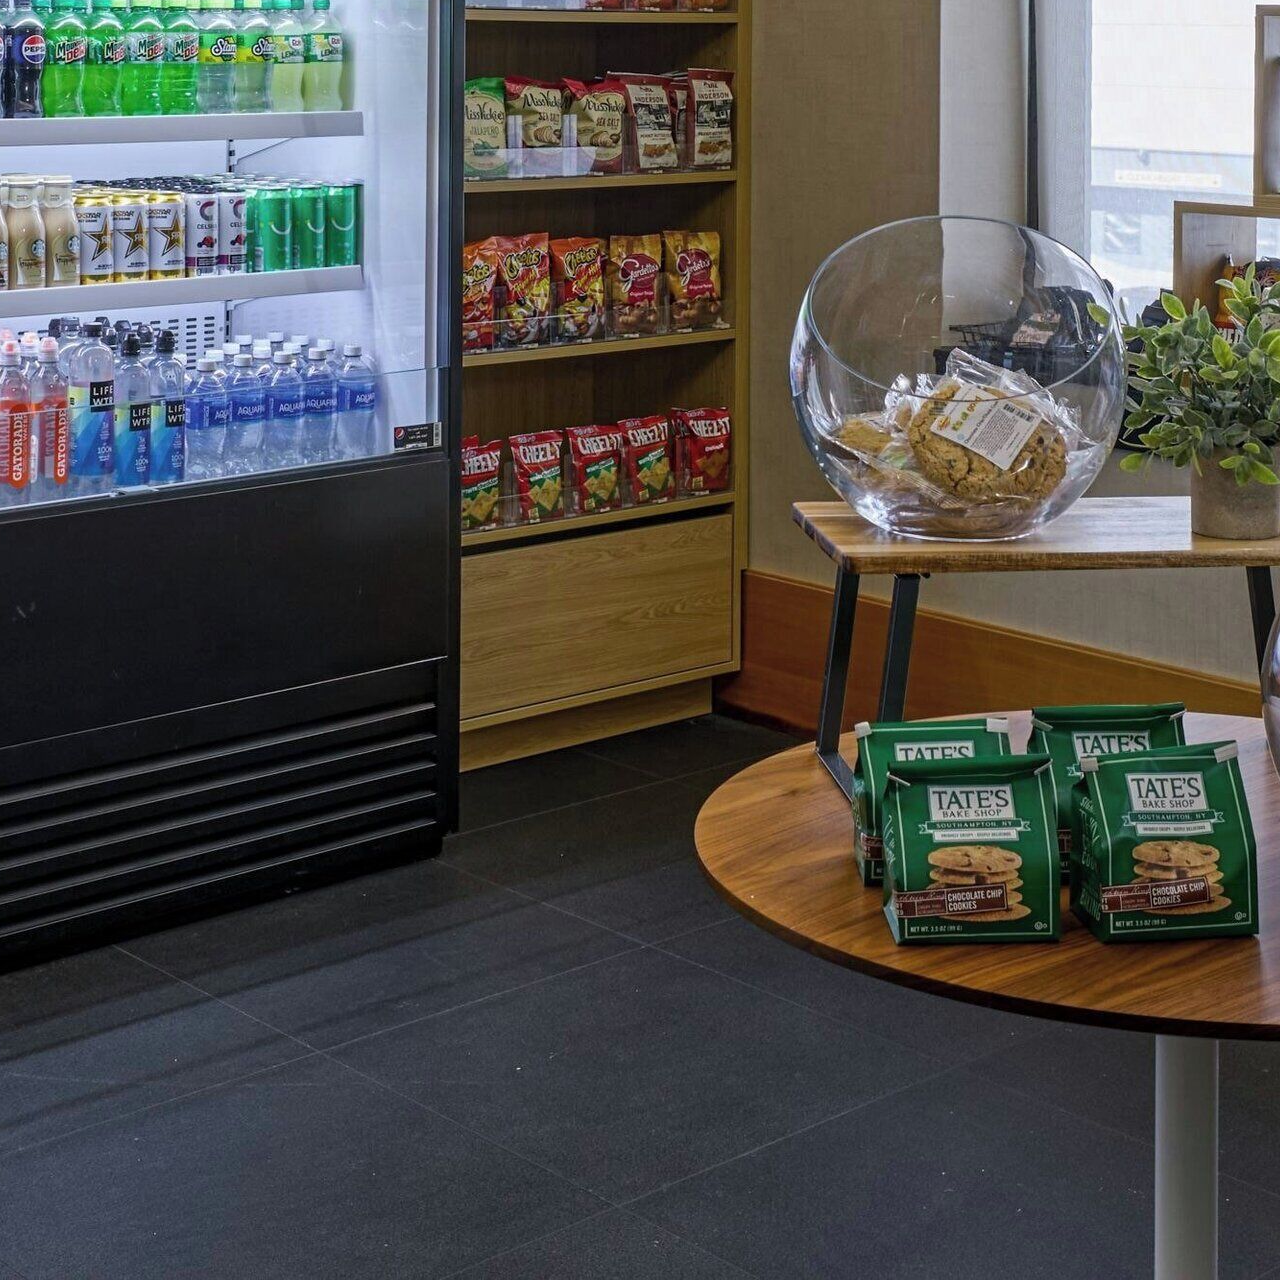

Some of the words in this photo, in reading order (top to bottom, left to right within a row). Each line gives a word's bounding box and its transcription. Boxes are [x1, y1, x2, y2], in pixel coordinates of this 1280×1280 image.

[93, 385, 113, 395] LIFE
[93, 397, 113, 406] WTR
[133, 408, 150, 417] LIFE
[133, 418, 150, 427] WTR
[12, 414, 23, 482] GATORADE
[57, 409, 67, 478] GATORADE
[1131, 777, 1201, 798] TATE'S
[932, 790, 1009, 810] TATE'S
[1142, 800, 1165, 808] BAKE
[1170, 799, 1194, 807] SHOP
[943, 810, 970, 818] BAKE
[974, 809, 1002, 817] SHOP
[1152, 884, 1188, 896] CHOCOLATE
[1189, 882, 1204, 892] CHIP
[948, 891, 986, 902] CHOCOLATE
[987, 889, 1003, 898] CHIP
[1153, 895, 1181, 905] COOKIES
[948, 901, 977, 911] COOKIES
